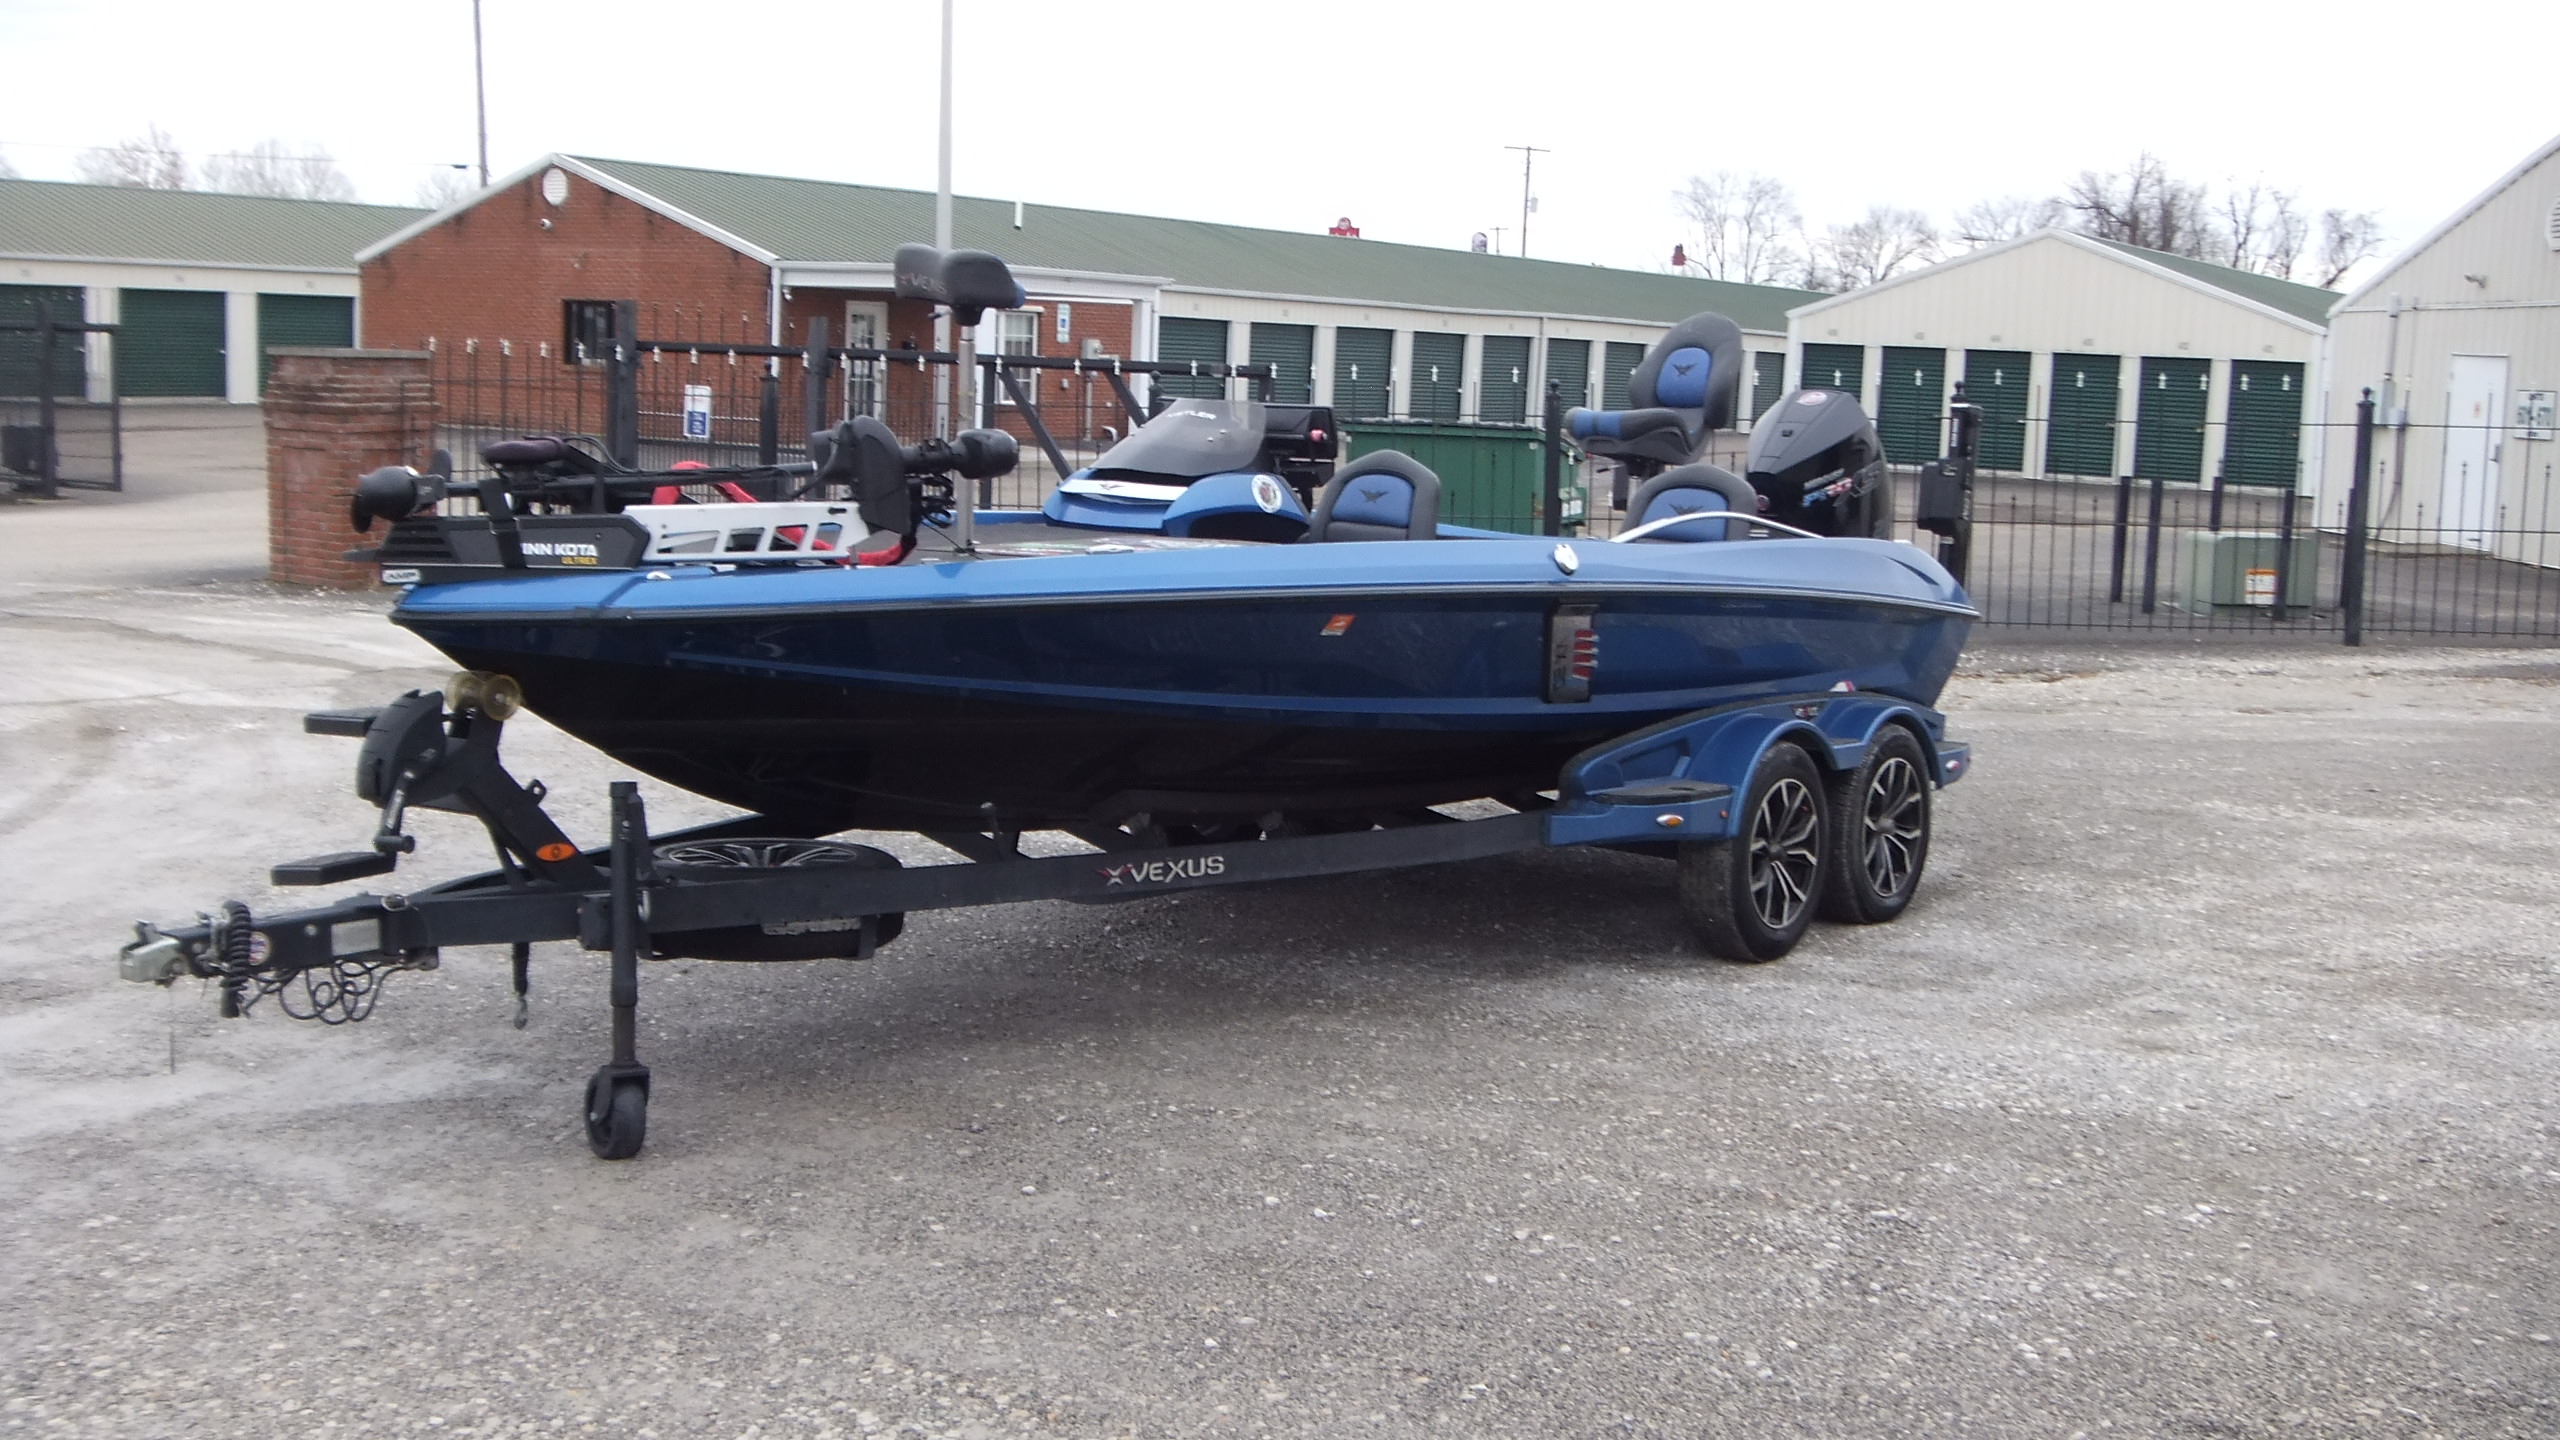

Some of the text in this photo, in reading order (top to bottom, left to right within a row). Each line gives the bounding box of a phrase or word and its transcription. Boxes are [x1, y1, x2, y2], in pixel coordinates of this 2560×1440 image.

[520, 543, 597, 556] INN KOTA
[1128, 856, 1225, 883] VEXUS
